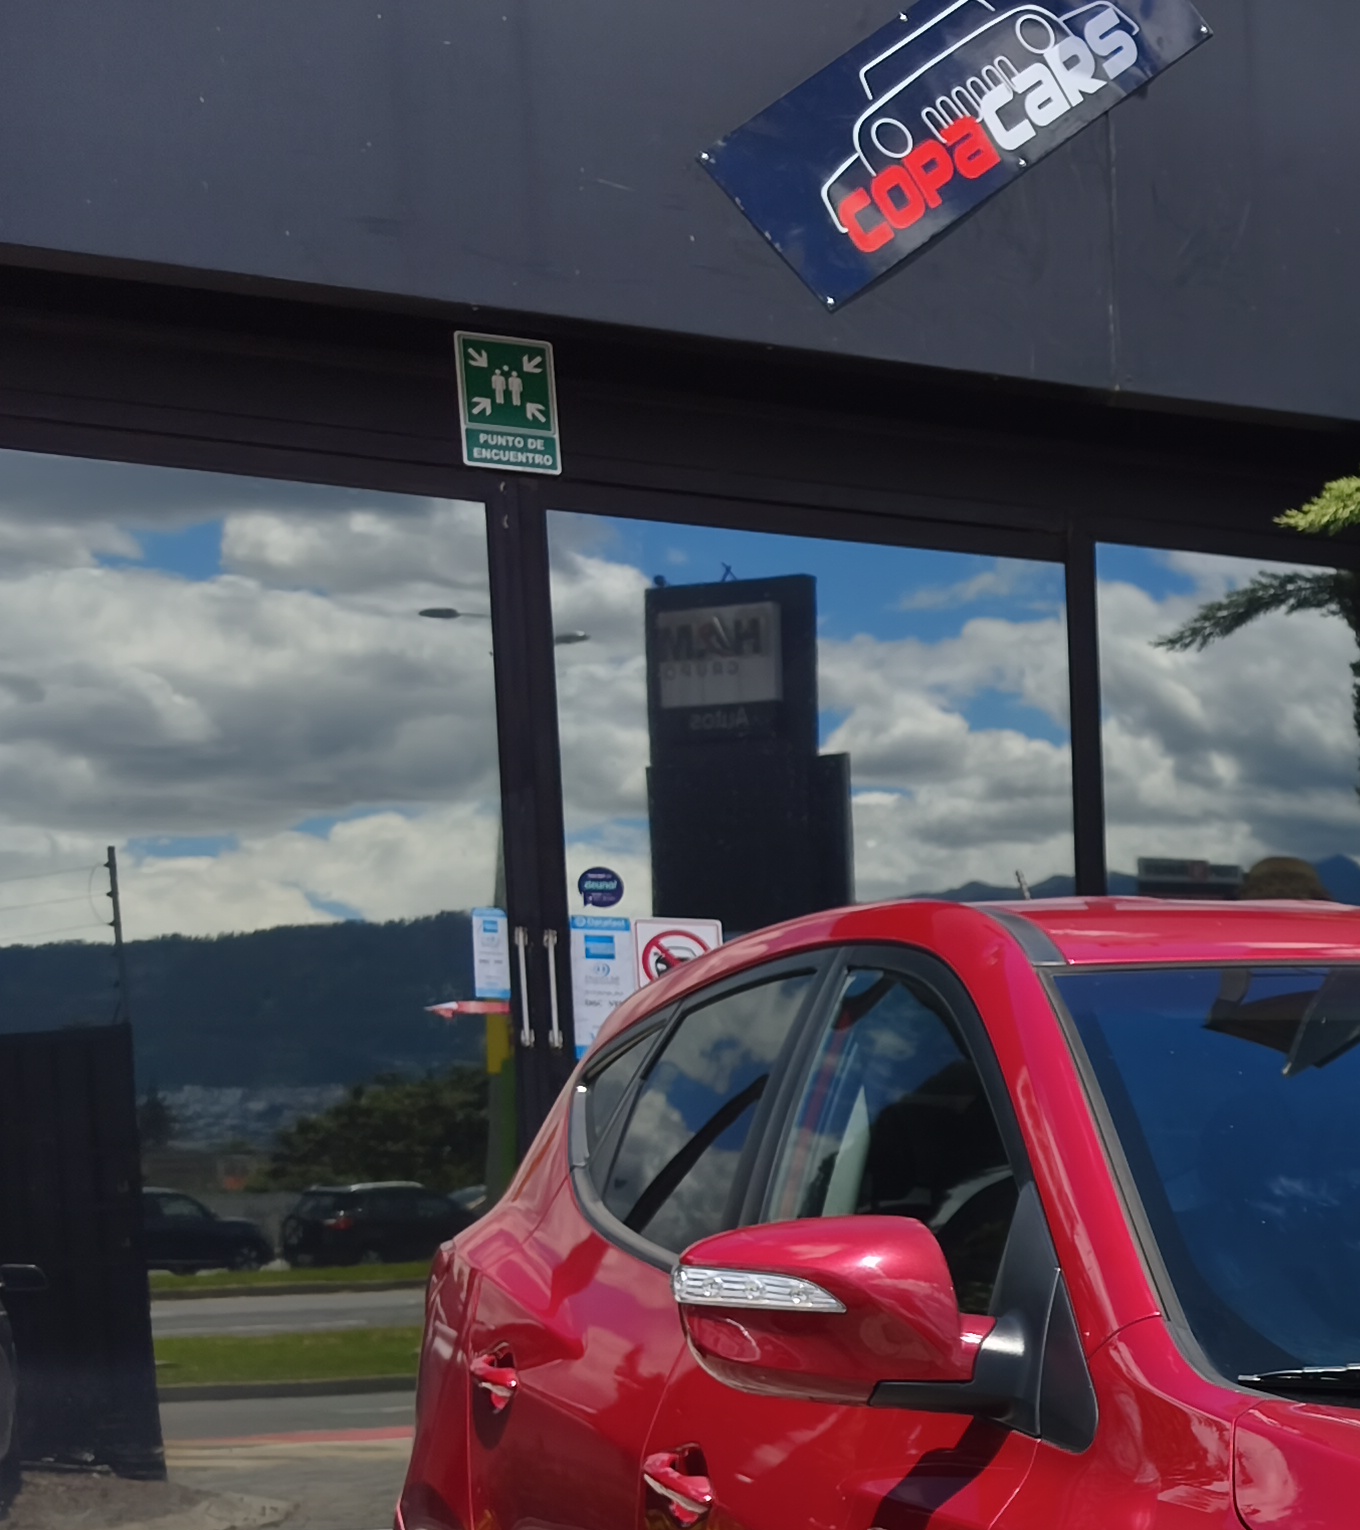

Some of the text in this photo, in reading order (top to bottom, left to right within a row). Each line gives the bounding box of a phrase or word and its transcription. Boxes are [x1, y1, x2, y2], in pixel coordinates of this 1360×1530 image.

[479, 433, 545, 450] PUNTO DE
[473, 447, 553, 466] ENCUENTRO
